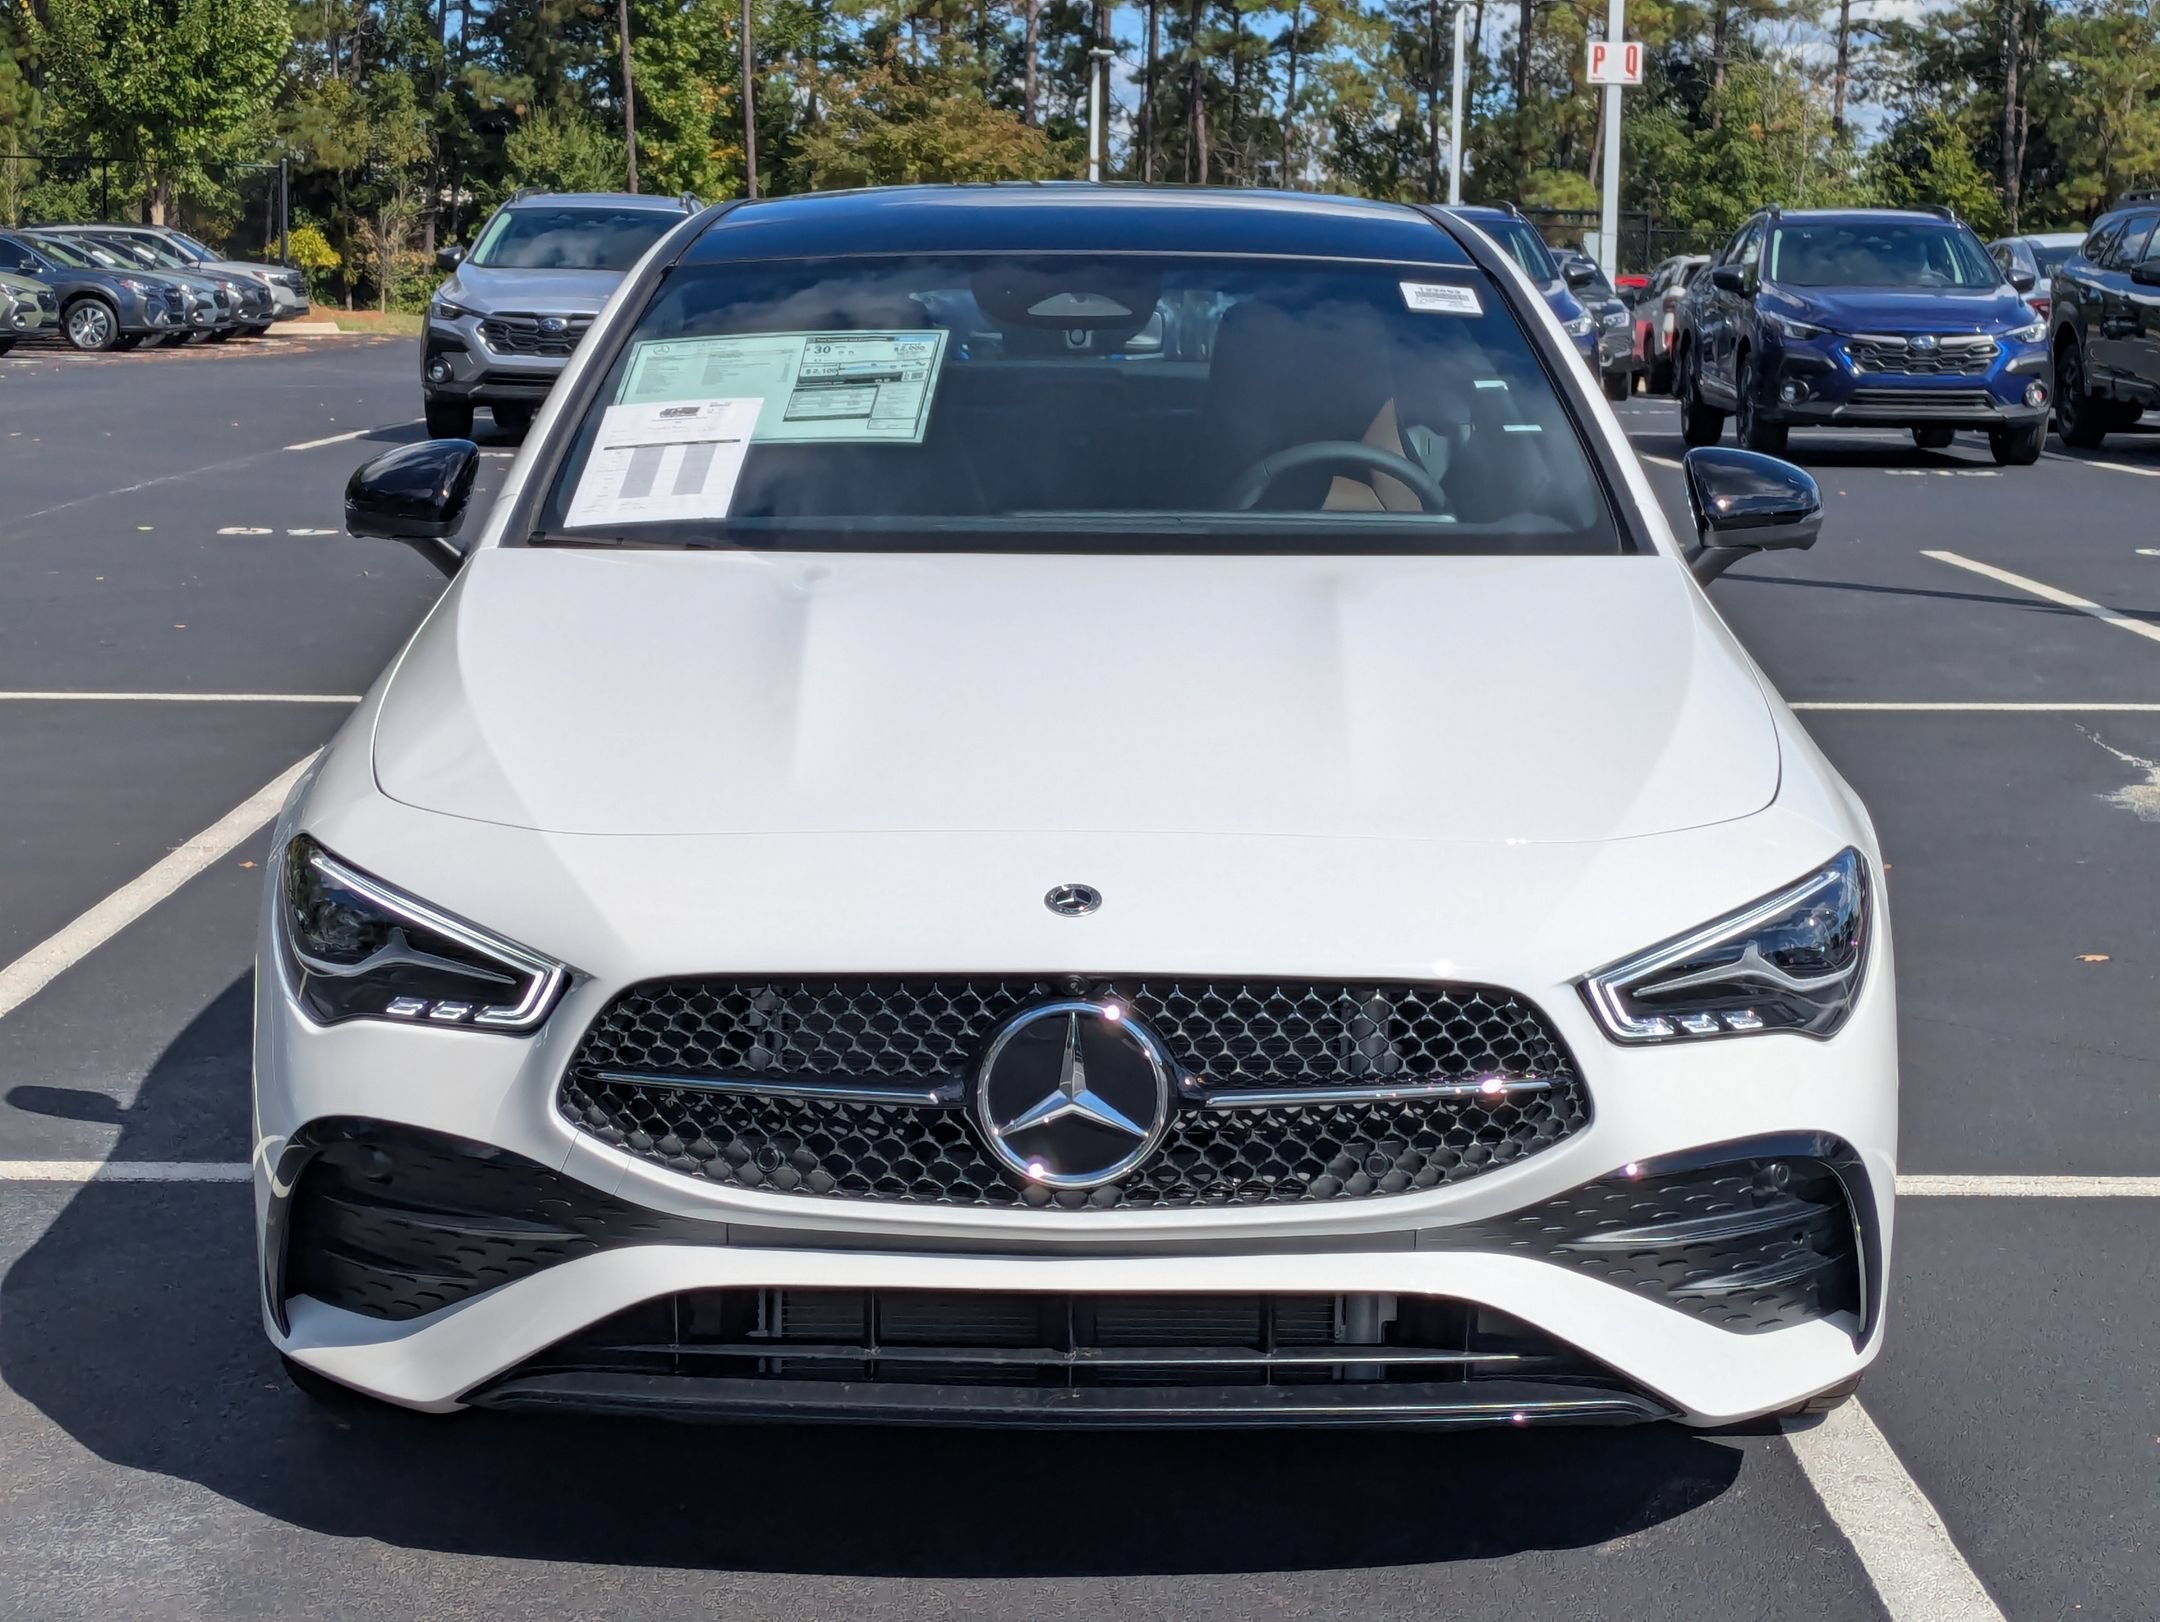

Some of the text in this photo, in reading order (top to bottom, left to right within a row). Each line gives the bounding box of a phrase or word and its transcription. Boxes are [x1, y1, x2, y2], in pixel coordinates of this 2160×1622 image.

[1593, 45, 1638, 76] P Q
[814, 345, 832, 354] 30
